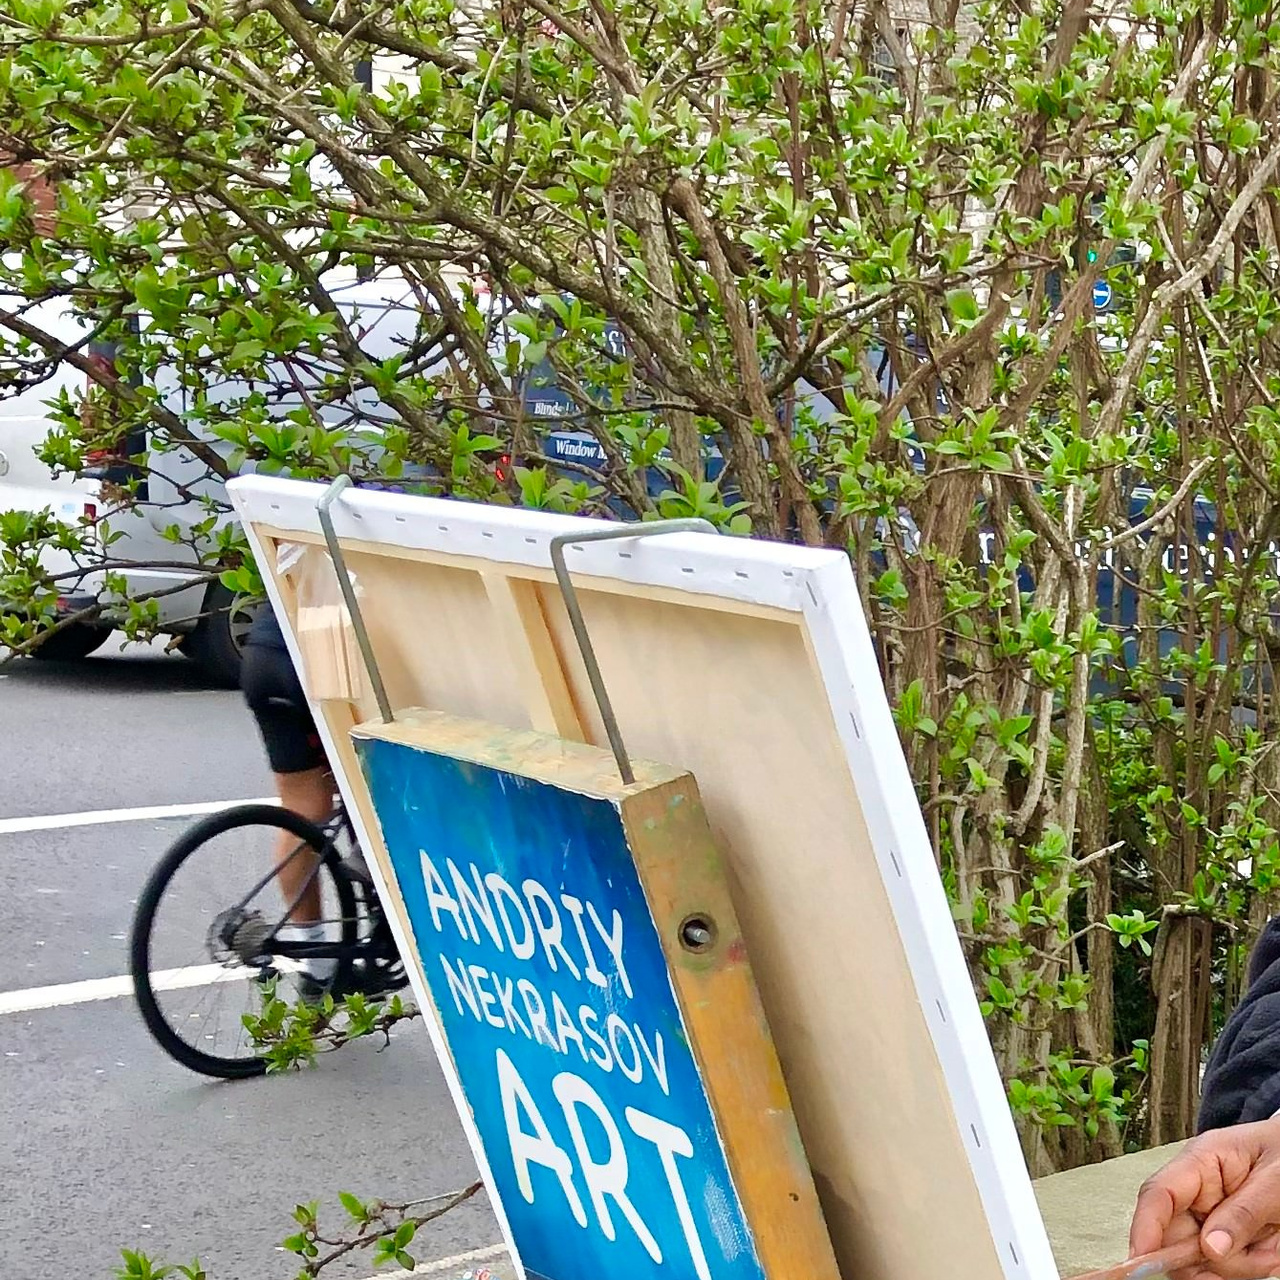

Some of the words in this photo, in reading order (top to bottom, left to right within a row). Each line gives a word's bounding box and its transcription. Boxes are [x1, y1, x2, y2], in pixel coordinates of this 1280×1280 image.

[555, 439, 597, 458] Window
[419, 848, 634, 999] ANDRIY
[440, 952, 670, 1096] NEKRASOV
